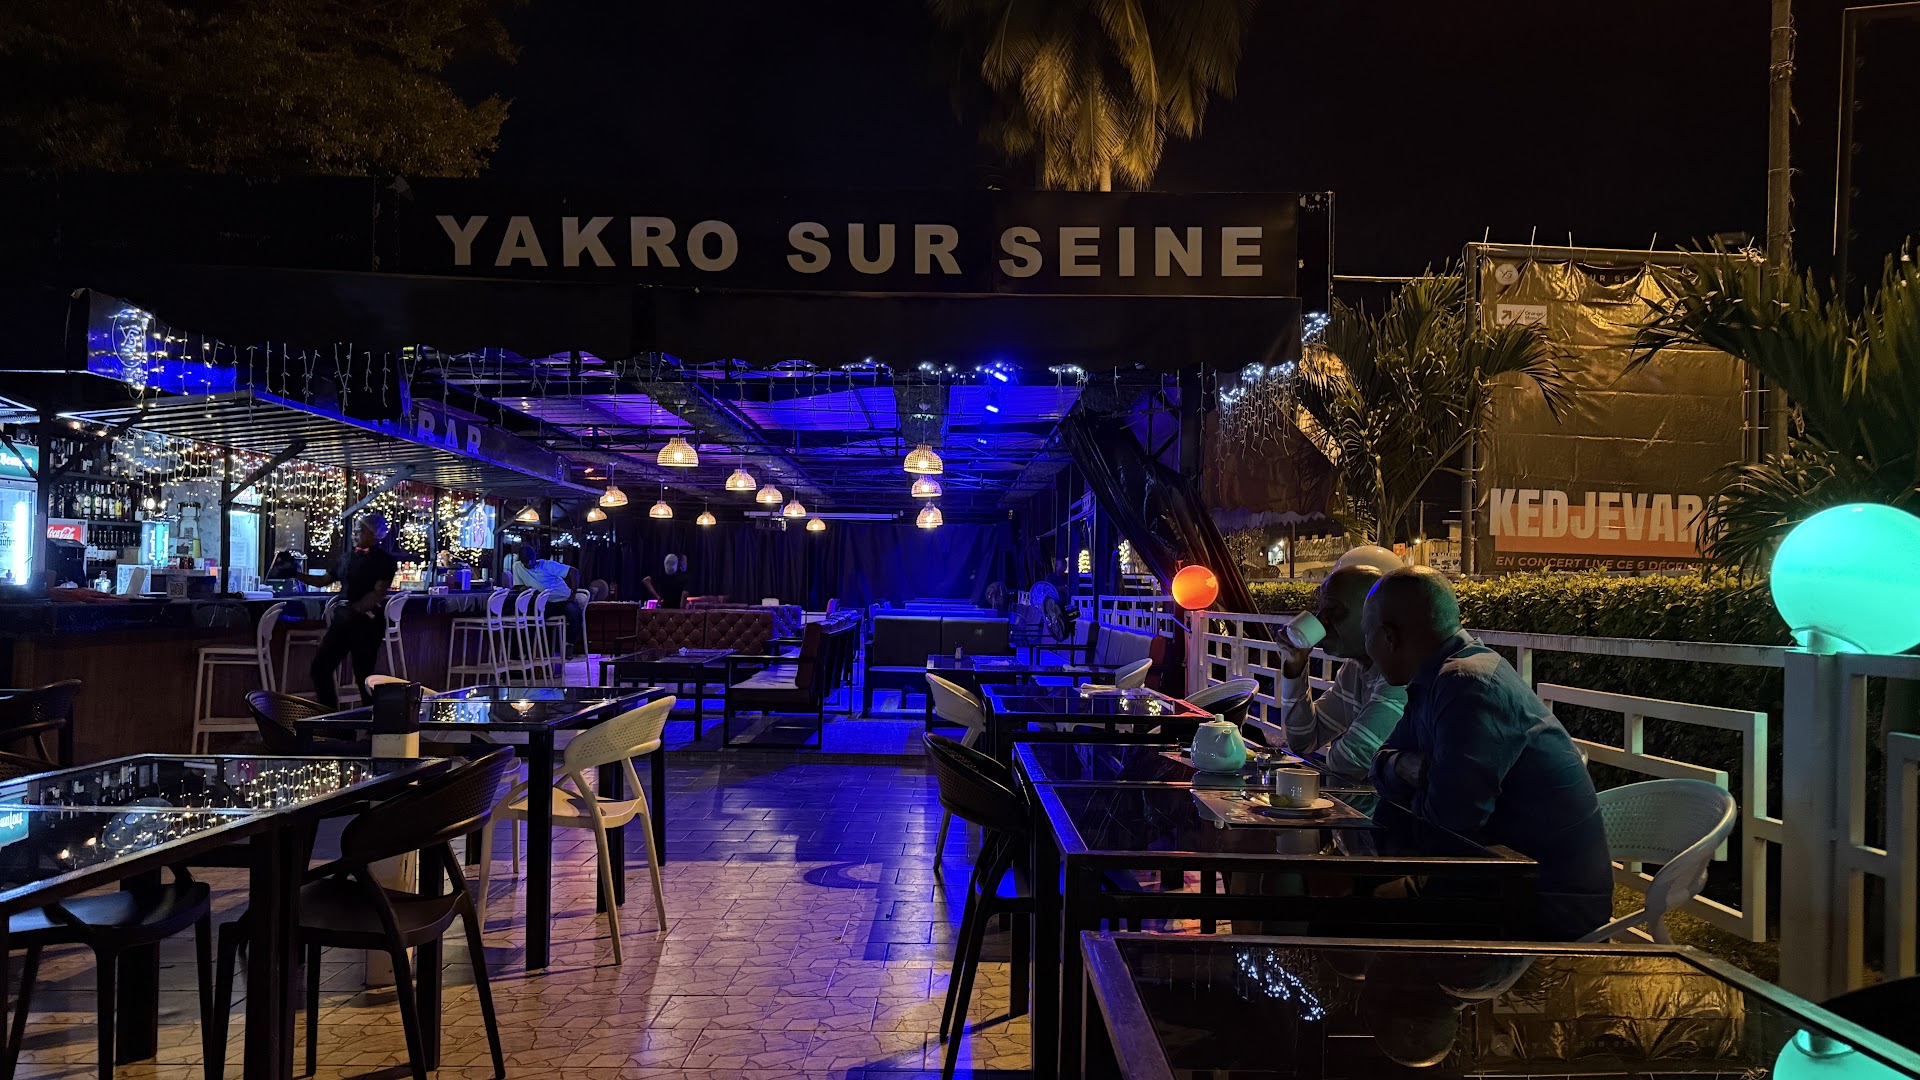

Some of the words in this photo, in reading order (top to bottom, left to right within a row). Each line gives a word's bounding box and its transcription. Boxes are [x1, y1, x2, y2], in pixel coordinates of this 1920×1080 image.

[435, 214, 739, 272] YAKRO
[786, 221, 962, 275] SUR
[998, 226, 1264, 278] SEINE
[417, 408, 482, 455] BAR
[1495, 556, 1515, 566] EN
[1518, 557, 1583, 568] CONCERT
[1584, 558, 1615, 569] LIVE
[1616, 560, 1634, 570] CE
[1636, 560, 1645, 570] 6
